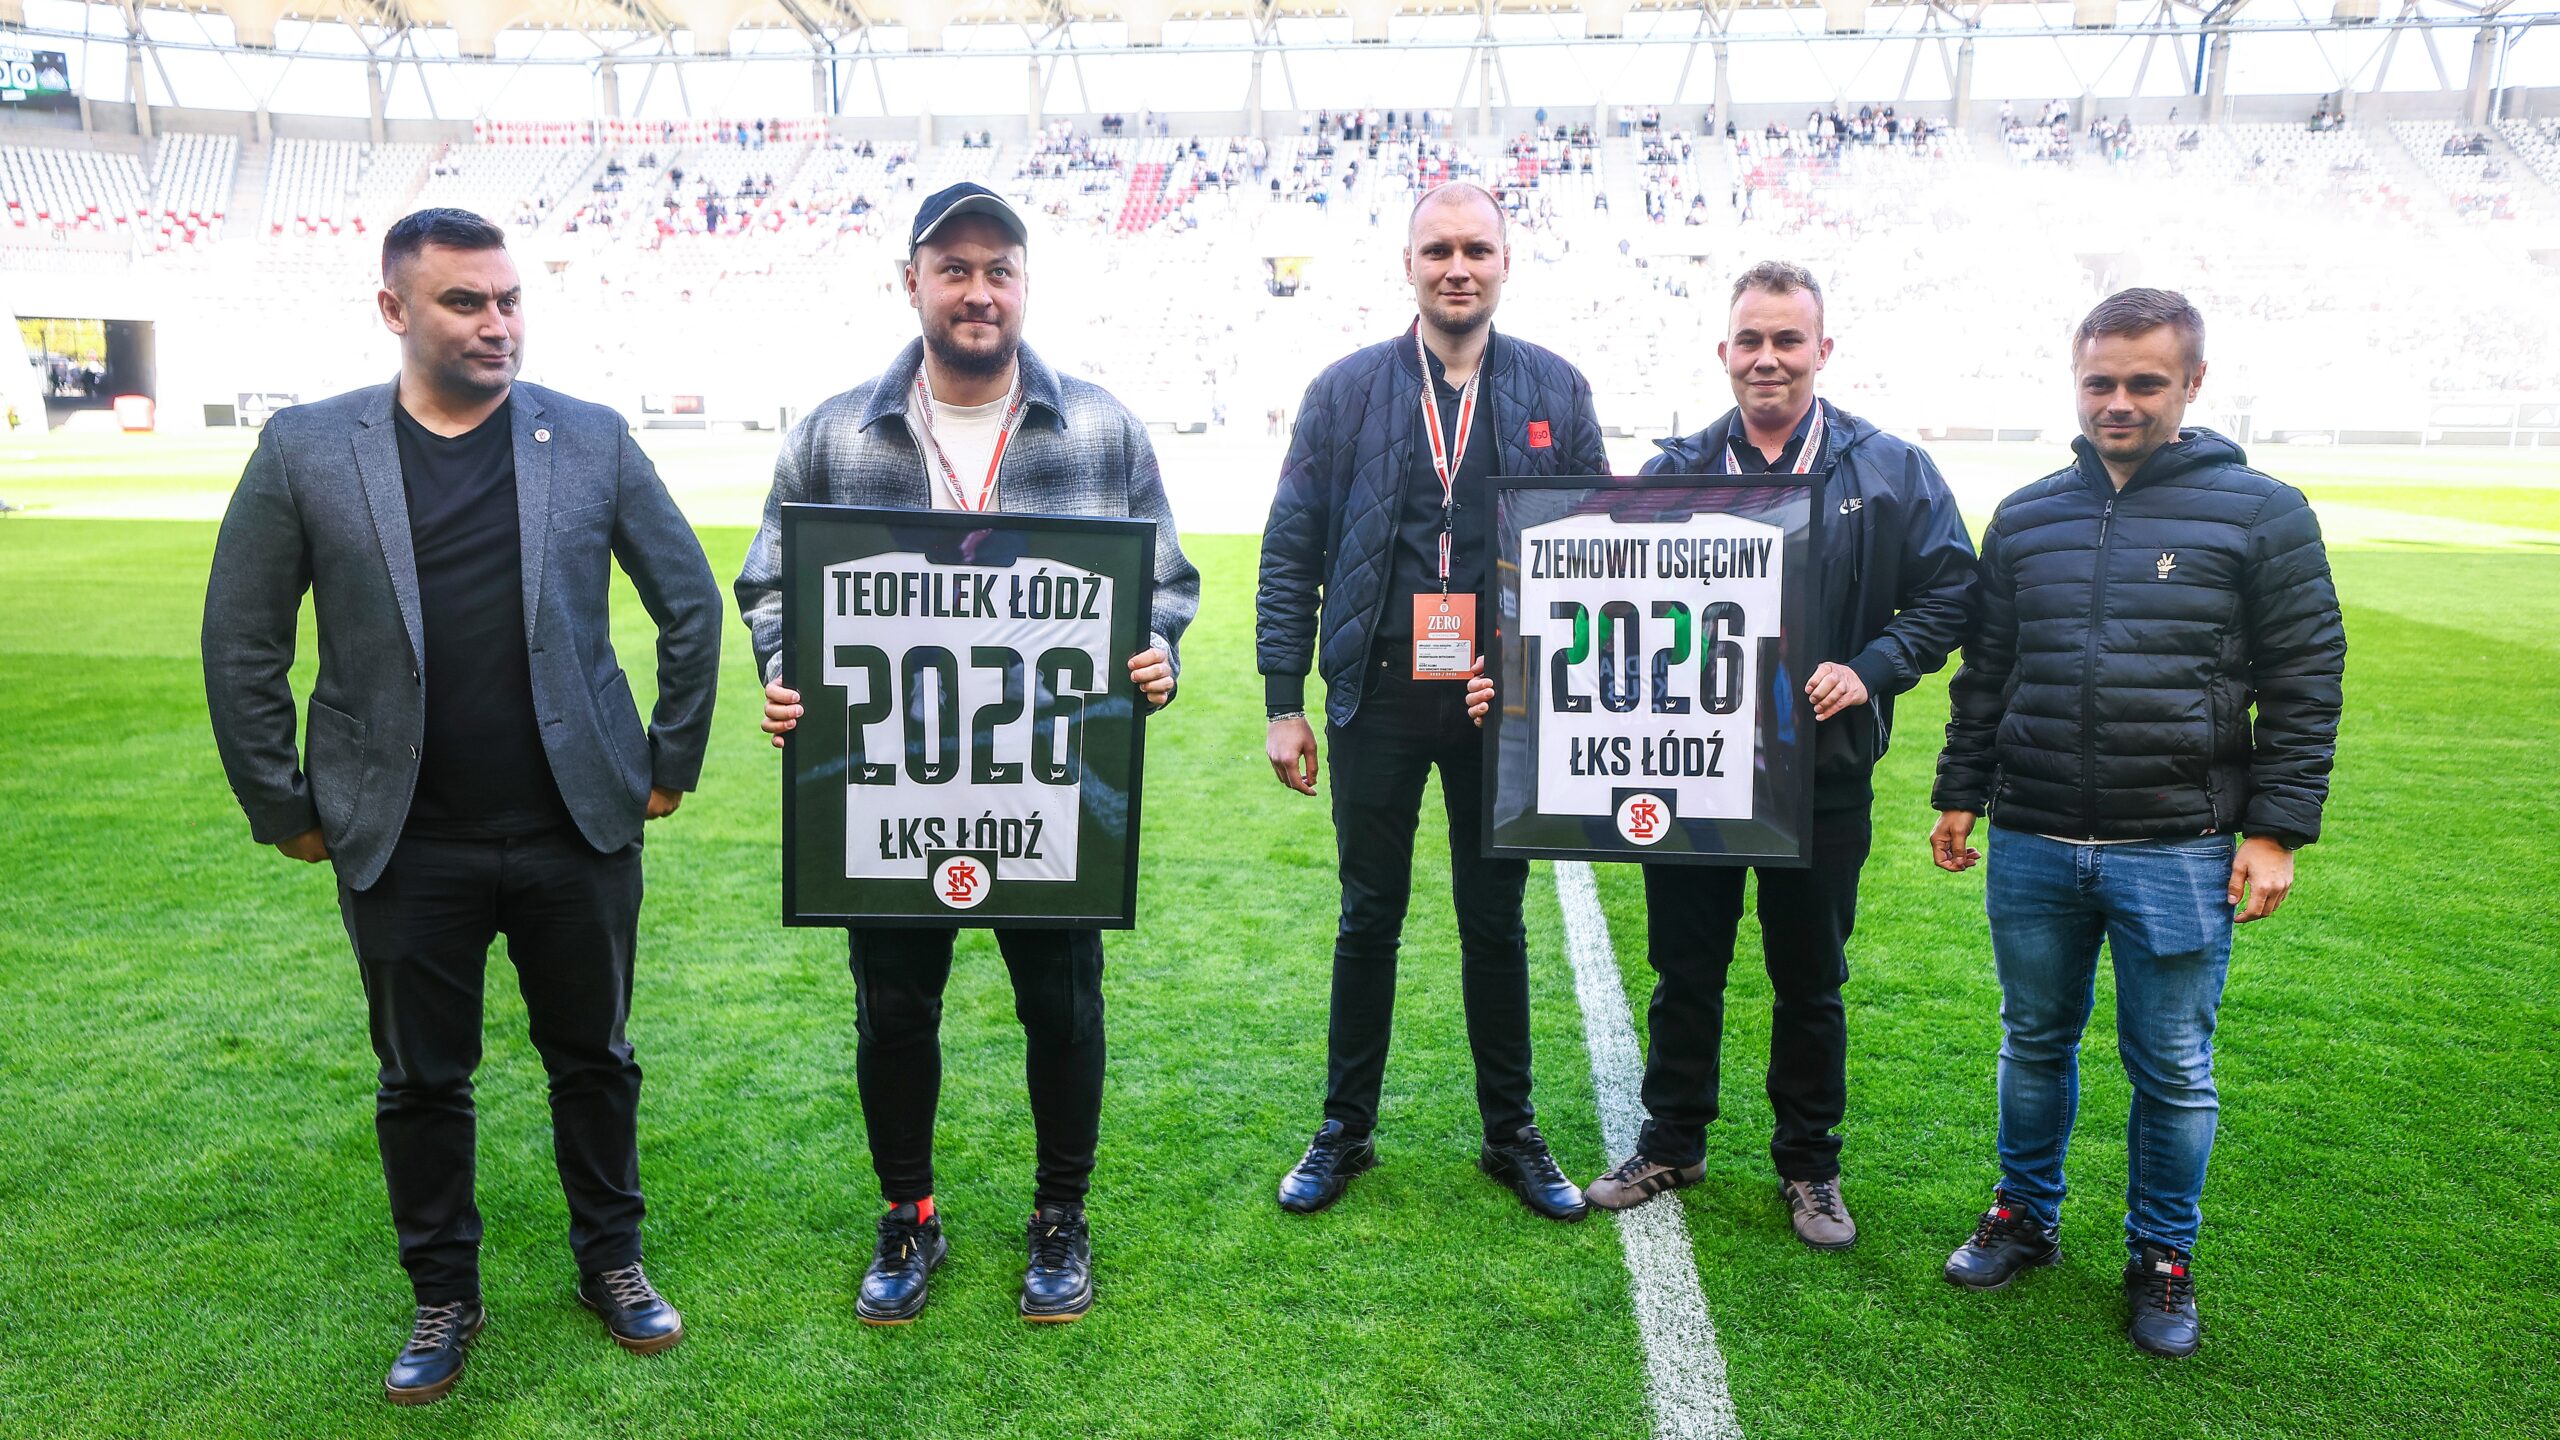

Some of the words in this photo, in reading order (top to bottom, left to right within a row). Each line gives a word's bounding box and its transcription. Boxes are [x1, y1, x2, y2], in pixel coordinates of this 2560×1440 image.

[1530, 538, 1650, 579] ZIEMOWIT
[1657, 537, 1773, 586] OSIĘCINY
[831, 570, 998, 618] TEOFILEK
[1009, 566, 1101, 620] ŁÓDŹ
[1427, 615, 1461, 631] ZERO
[1549, 600, 1746, 715] 2026
[833, 644, 1095, 786] 2026
[1569, 735, 1632, 777] ŁKS
[1641, 729, 1725, 778] ŁÓDŹ
[878, 815, 947, 861] ŁKS
[956, 810, 1043, 861] ŁÓDŹ
